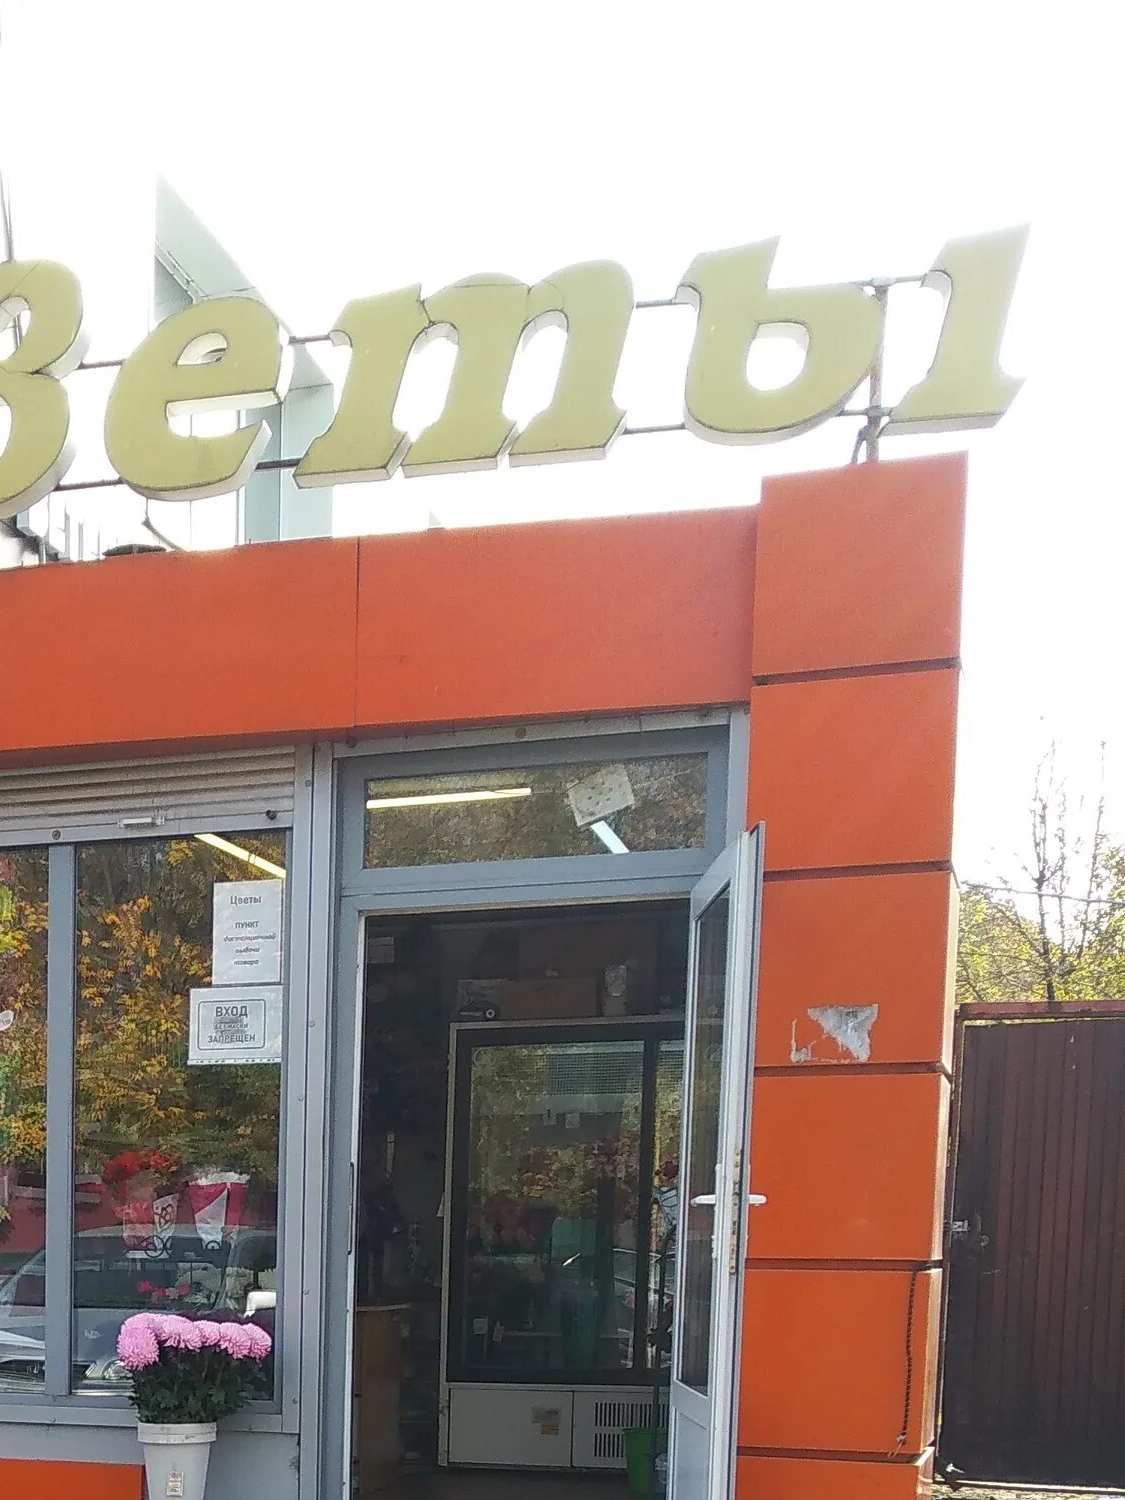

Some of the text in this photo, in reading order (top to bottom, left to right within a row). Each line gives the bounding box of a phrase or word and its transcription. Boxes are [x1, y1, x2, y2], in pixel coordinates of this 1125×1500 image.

[230, 895, 262, 906] Цветы
[215, 1005, 248, 1018] ВХОД
[207, 1034, 256, 1044] ЗАПРЕЩЕН
